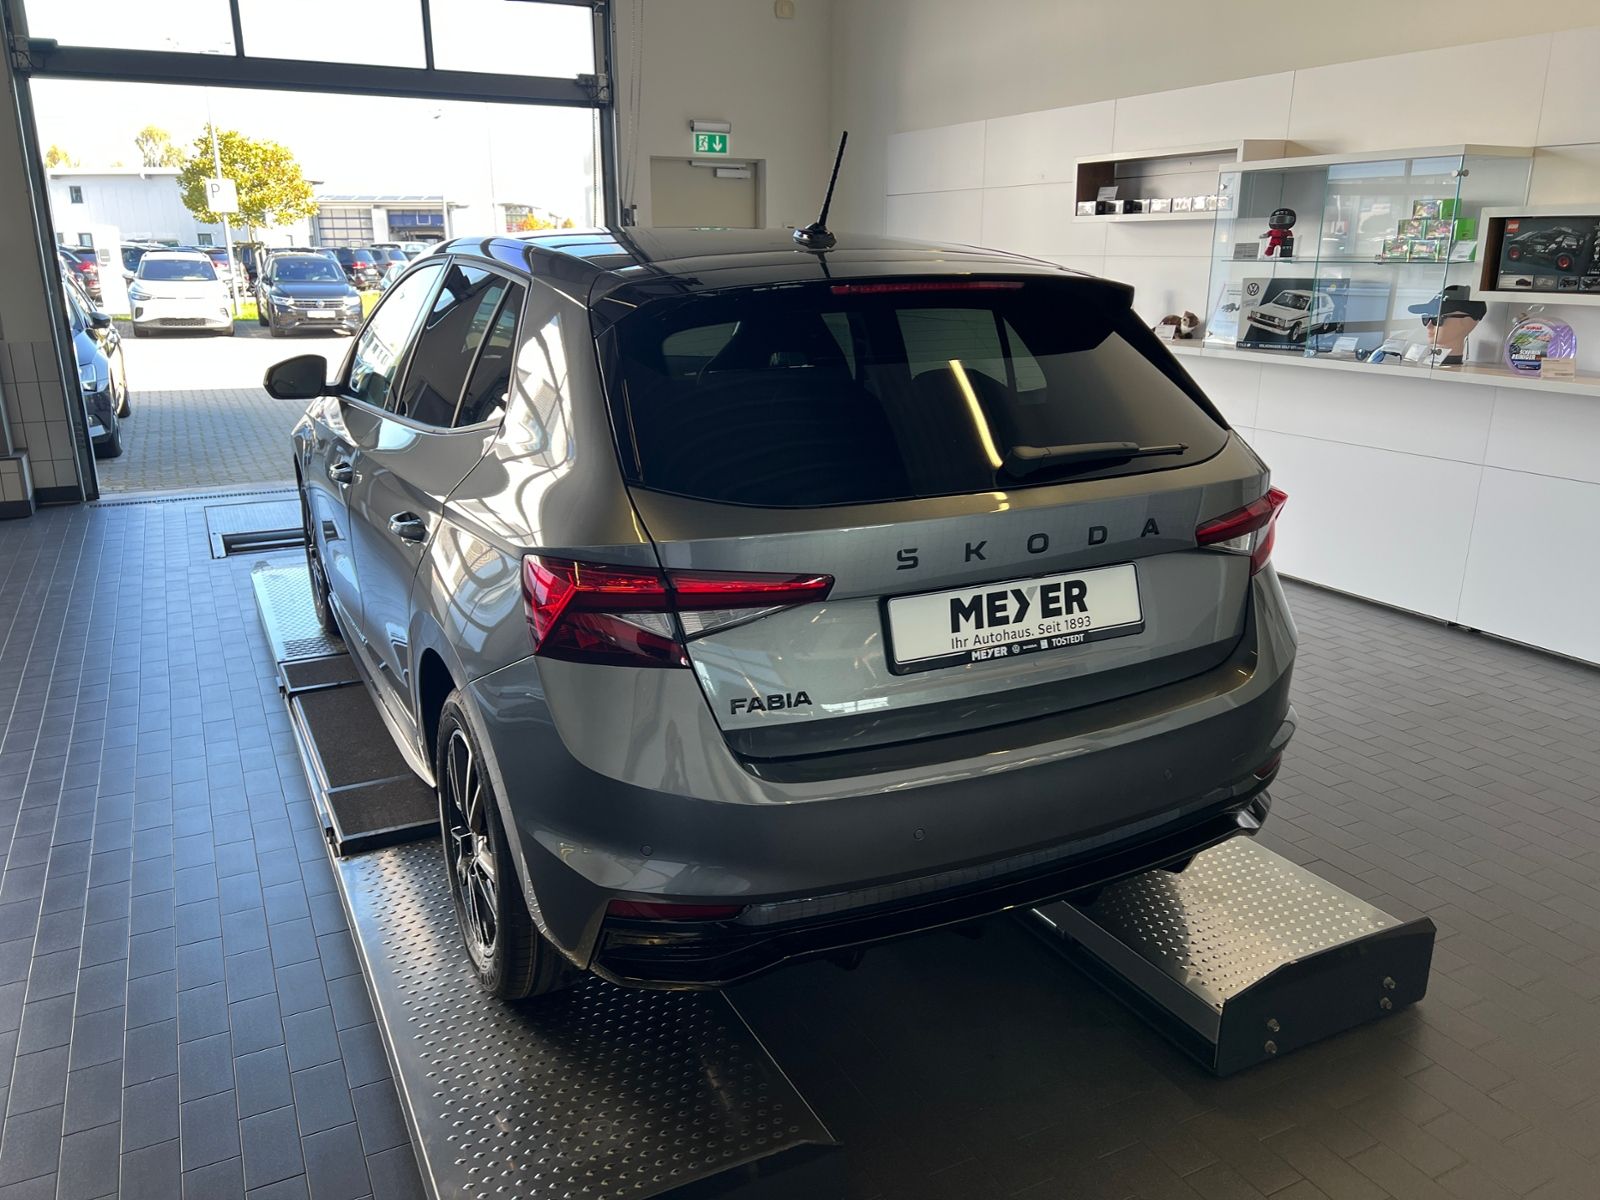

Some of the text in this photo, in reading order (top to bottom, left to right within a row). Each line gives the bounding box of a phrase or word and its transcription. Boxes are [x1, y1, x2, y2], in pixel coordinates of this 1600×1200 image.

[210, 183, 221, 199] P
[896, 517, 1160, 571] SKODA
[949, 579, 1088, 634] MEYER
[951, 637, 968, 650] Ihr
[973, 628, 1035, 647] Autohaus.
[1038, 621, 1062, 636] Seit
[1064, 615, 1092, 631] 1893
[971, 645, 1008, 662] MEYER
[1051, 633, 1085, 647] TOSTEDT
[730, 690, 813, 715] FABIA
